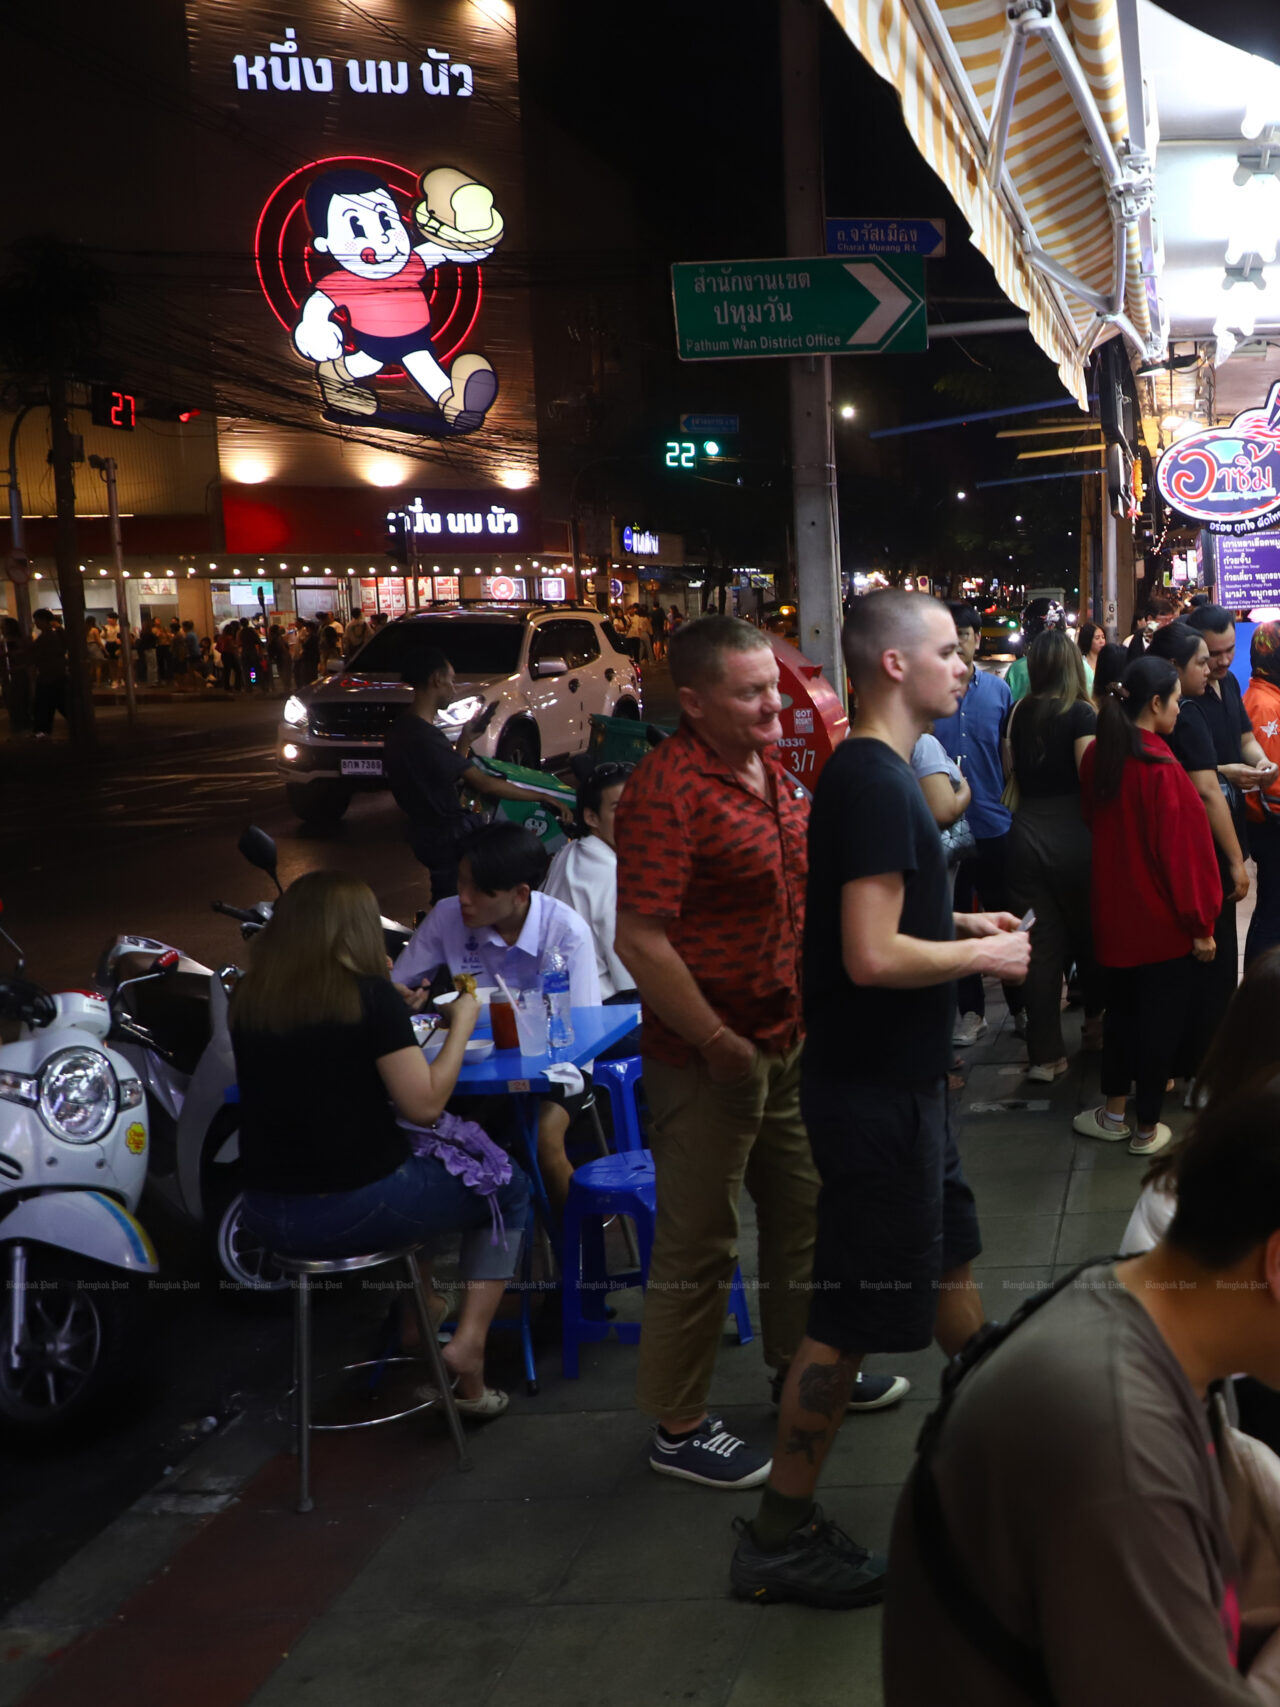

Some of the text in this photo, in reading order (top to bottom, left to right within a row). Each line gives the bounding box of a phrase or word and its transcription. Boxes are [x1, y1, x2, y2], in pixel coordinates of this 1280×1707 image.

[233, 28, 474, 97] หนึ่ง นม นัว
[694, 266, 811, 293] สำนักงานเขต
[713, 295, 793, 333] ปทุมวัน
[685, 333, 841, 352] Pathum Wan District Office
[111, 391, 136, 427] 27
[665, 441, 696, 467] 22
[447, 512, 483, 533] นม
[487, 505, 519, 534] นัว
[1108, 603, 1115, 613] 6
[791, 748, 816, 773] 3/7
